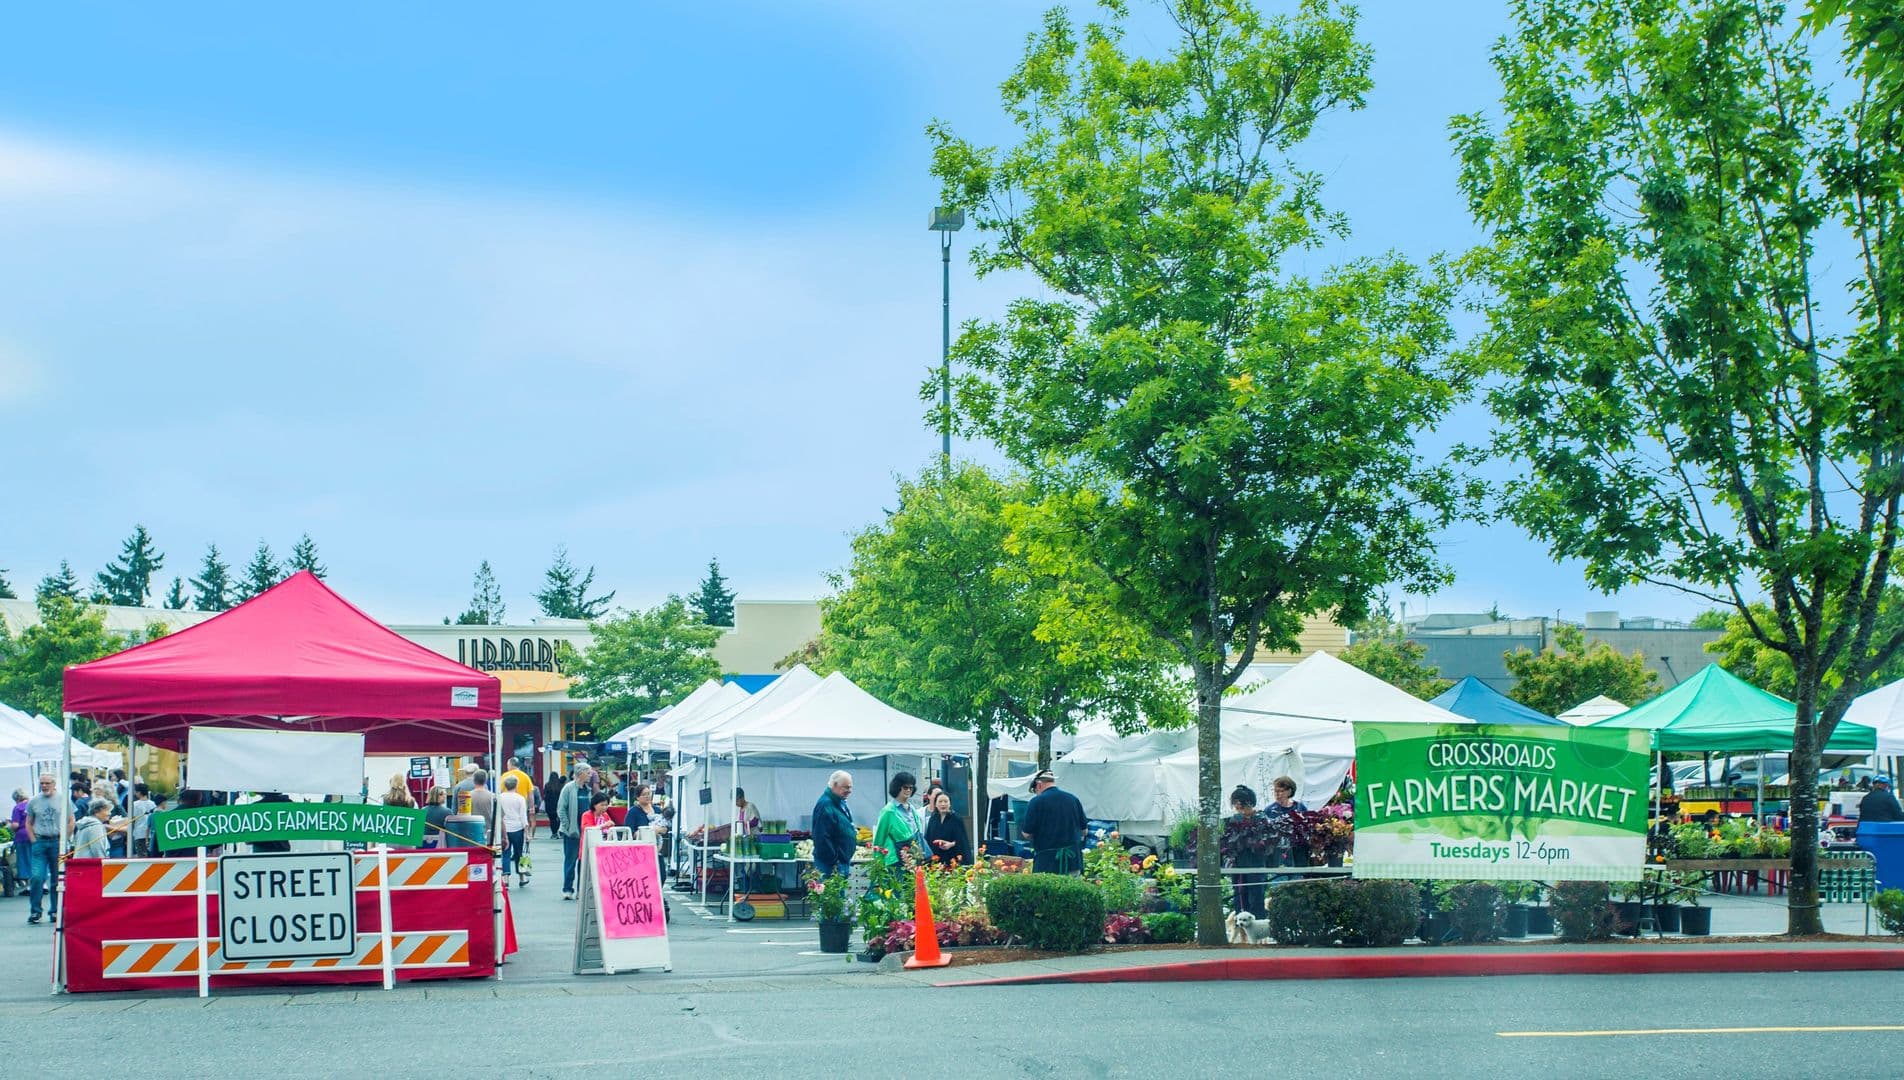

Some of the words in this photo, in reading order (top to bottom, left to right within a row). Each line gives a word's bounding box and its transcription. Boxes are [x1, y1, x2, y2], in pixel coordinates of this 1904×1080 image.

[1428, 743, 1556, 770] CROSSROADS
[1367, 775, 1505, 820] FARMERS
[1514, 775, 1637, 824] MARKET
[165, 811, 273, 840] CROSSROADS
[277, 811, 348, 832] FARMERS
[352, 813, 416, 837] MARKET
[1430, 842, 1510, 863] Tuesdays
[1516, 841, 1570, 863] 12-6pm
[234, 868, 341, 899] STREET
[609, 876, 652, 900] KETTLE
[617, 902, 653, 925] CORN
[230, 913, 346, 944] CLOSED
